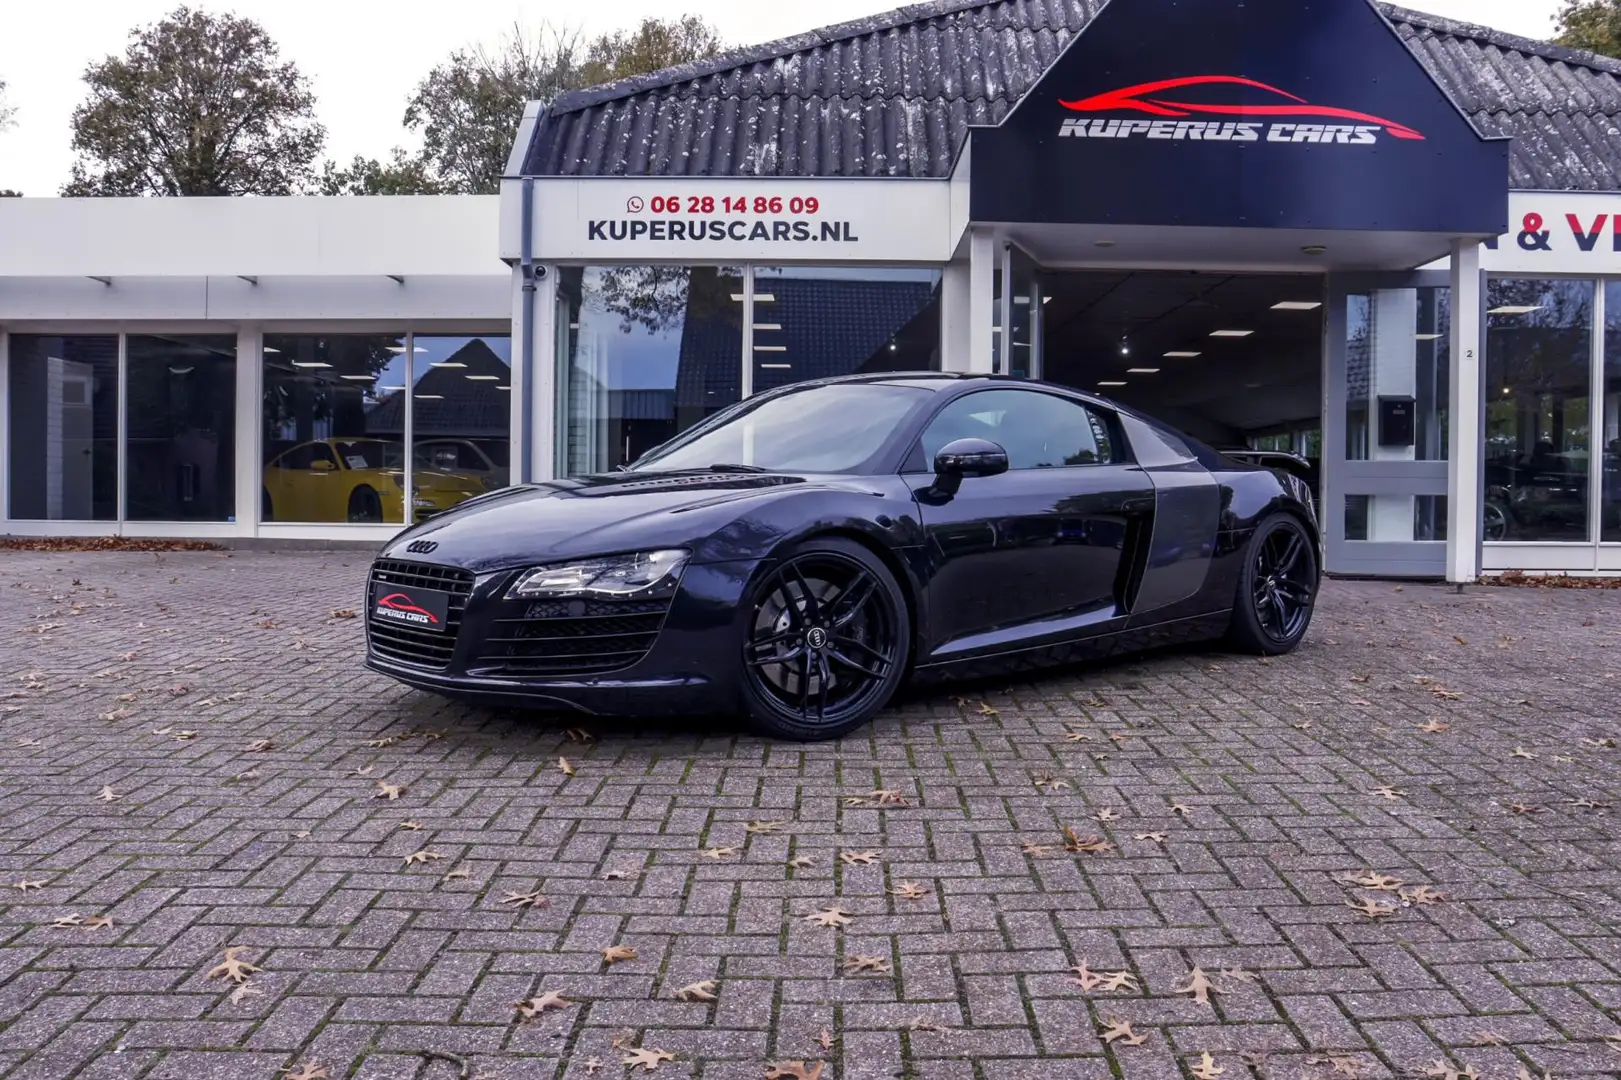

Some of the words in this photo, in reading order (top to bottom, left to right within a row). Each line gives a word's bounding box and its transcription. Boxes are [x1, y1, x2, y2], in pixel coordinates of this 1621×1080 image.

[1058, 118, 1263, 140] KUPERUS
[1266, 123, 1381, 143] CARS
[650, 196, 680, 214] 06
[687, 196, 715, 214] 28
[721, 196, 747, 214] 14
[753, 196, 783, 214] 86
[789, 196, 819, 214] 09
[588, 220, 859, 242] KUPERUSCARS.NL
[1516, 212, 1552, 251] &
[1466, 349, 1473, 358] 2
[406, 612, 430, 624] CARS
